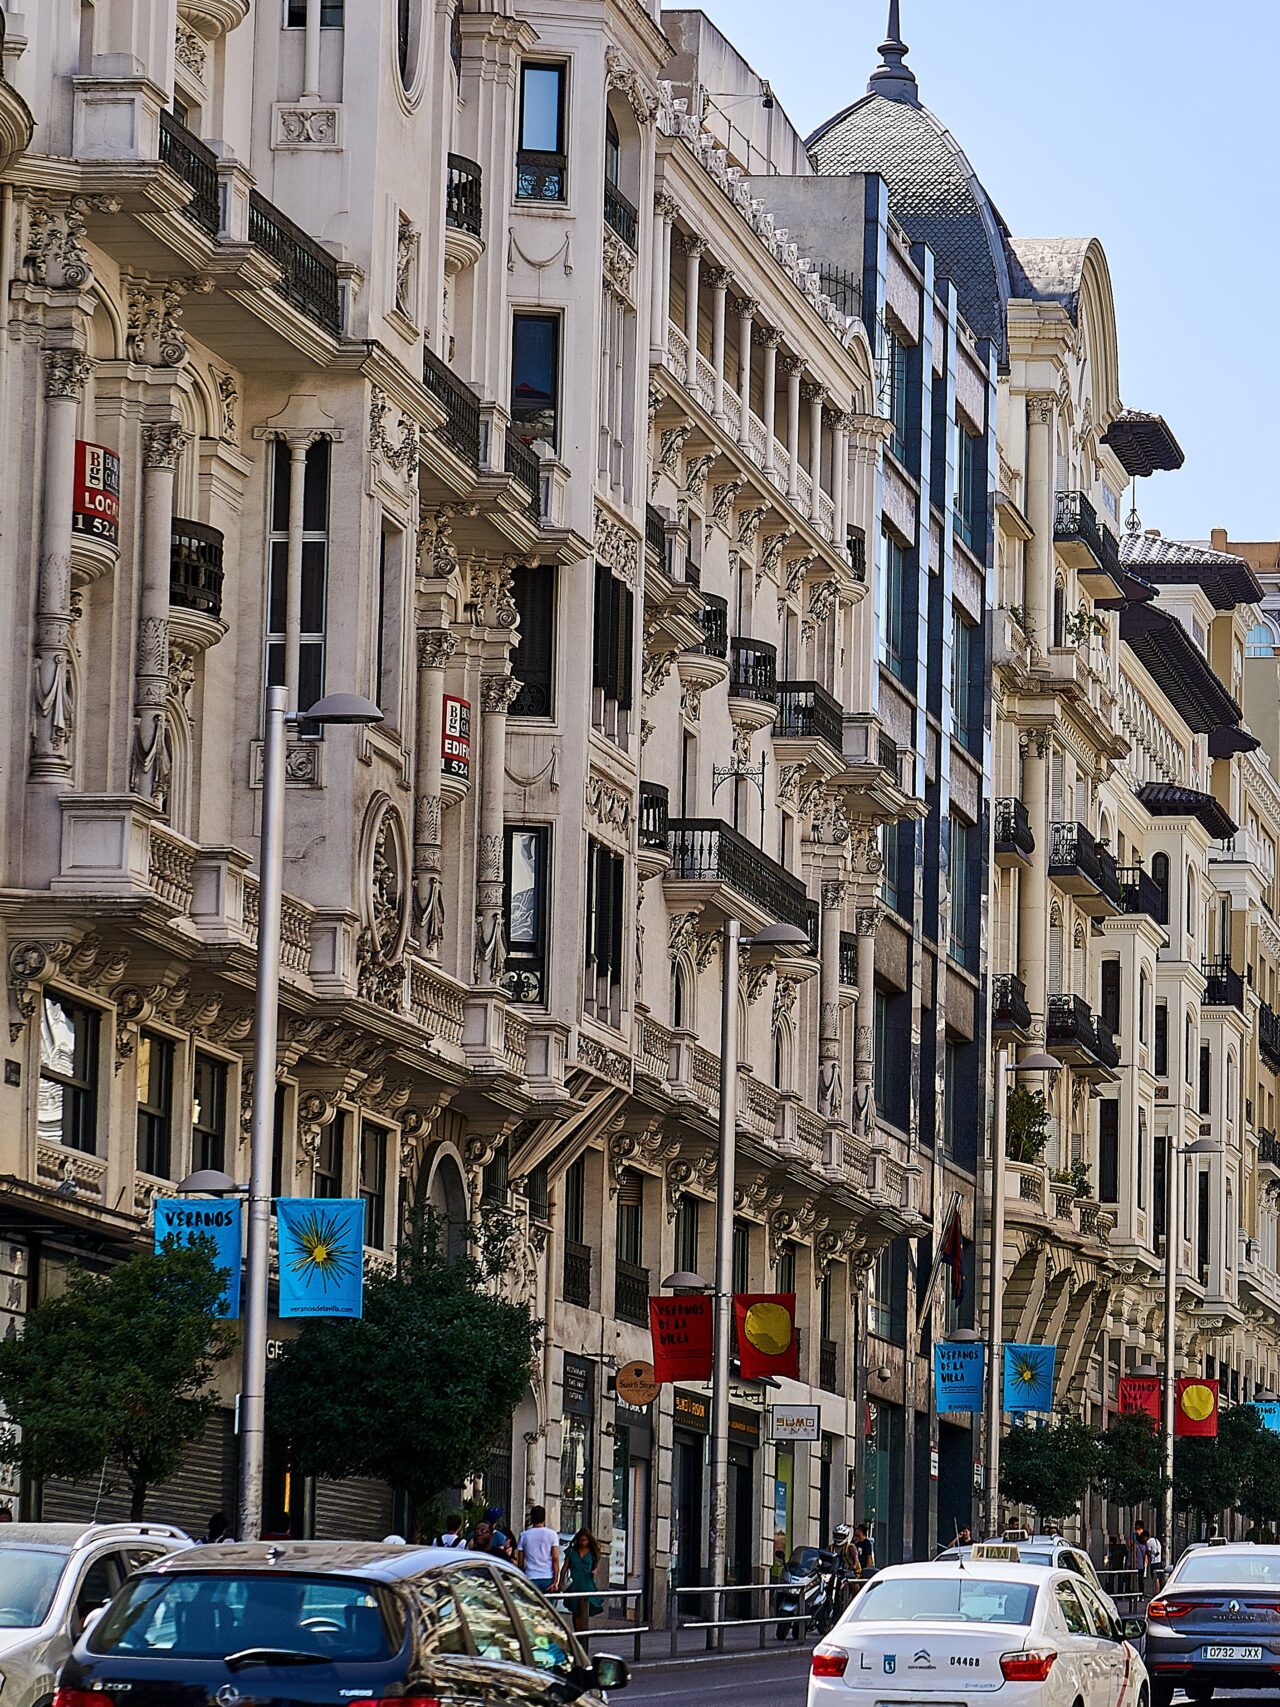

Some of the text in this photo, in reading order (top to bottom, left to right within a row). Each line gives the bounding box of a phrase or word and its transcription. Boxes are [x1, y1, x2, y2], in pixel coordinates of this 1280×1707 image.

[165, 1211, 233, 1228] VERANOS
[940, 1350, 979, 1360] VERANOS
[987, 1547, 1008, 1558] TAXI
[1209, 1647, 1259, 1658] 0732 JXX
